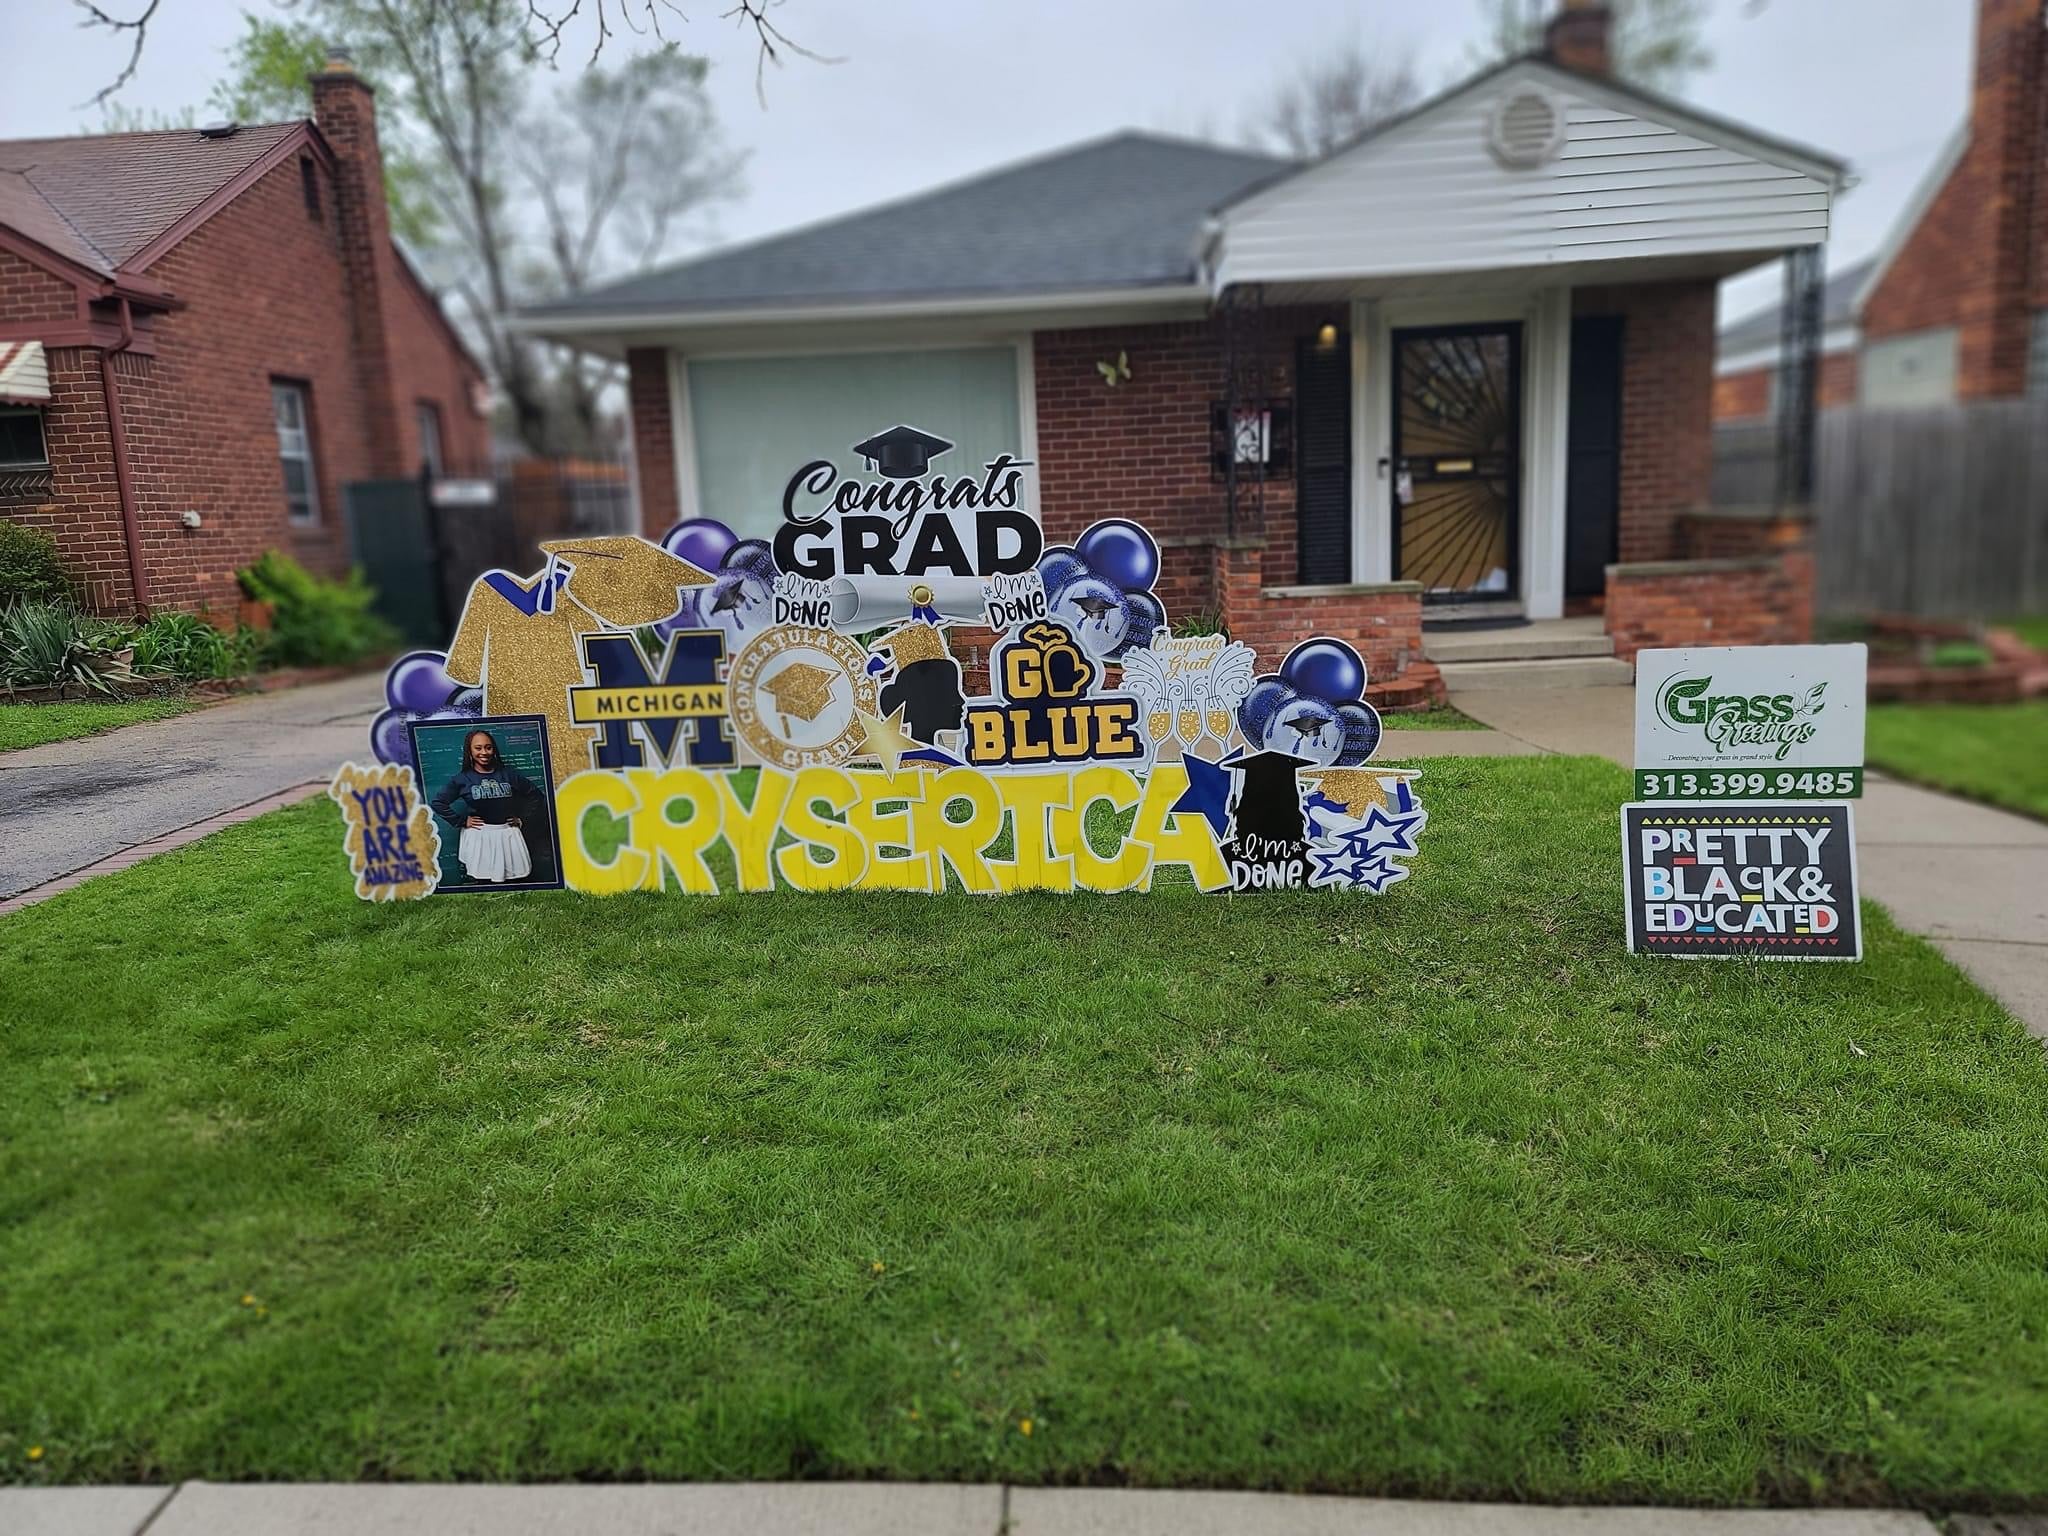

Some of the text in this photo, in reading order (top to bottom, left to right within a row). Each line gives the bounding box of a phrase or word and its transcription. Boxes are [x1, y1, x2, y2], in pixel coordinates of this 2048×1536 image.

[783, 456, 1034, 539] Congrats
[773, 511, 1042, 580] GRAD
[782, 573, 822, 599] I'm
[993, 573, 1030, 600] I'm
[1153, 635, 1223, 657] Congrats
[737, 629, 873, 724] CONGRATULATIONS
[1165, 652, 1217, 680] Grad
[582, 631, 737, 768] M
[597, 693, 722, 714] MICHIGAN
[1665, 675, 1795, 724] Grass
[969, 704, 1134, 760] BLUE
[1704, 707, 1817, 760] Greetings
[1716, 754, 1731, 762] grass
[1739, 753, 1758, 762] grand
[1643, 772, 1855, 796] 313.399.9485
[352, 785, 408, 826] YOU
[363, 824, 417, 864] ARE
[555, 767, 1235, 896] CRYSERICA
[1240, 833, 1291, 861] I'm
[1641, 828, 1833, 865] PRETTY
[364, 862, 424, 886] AMAZING
[1231, 860, 1303, 891] DONE
[1646, 903, 1840, 934] EDUCATED
